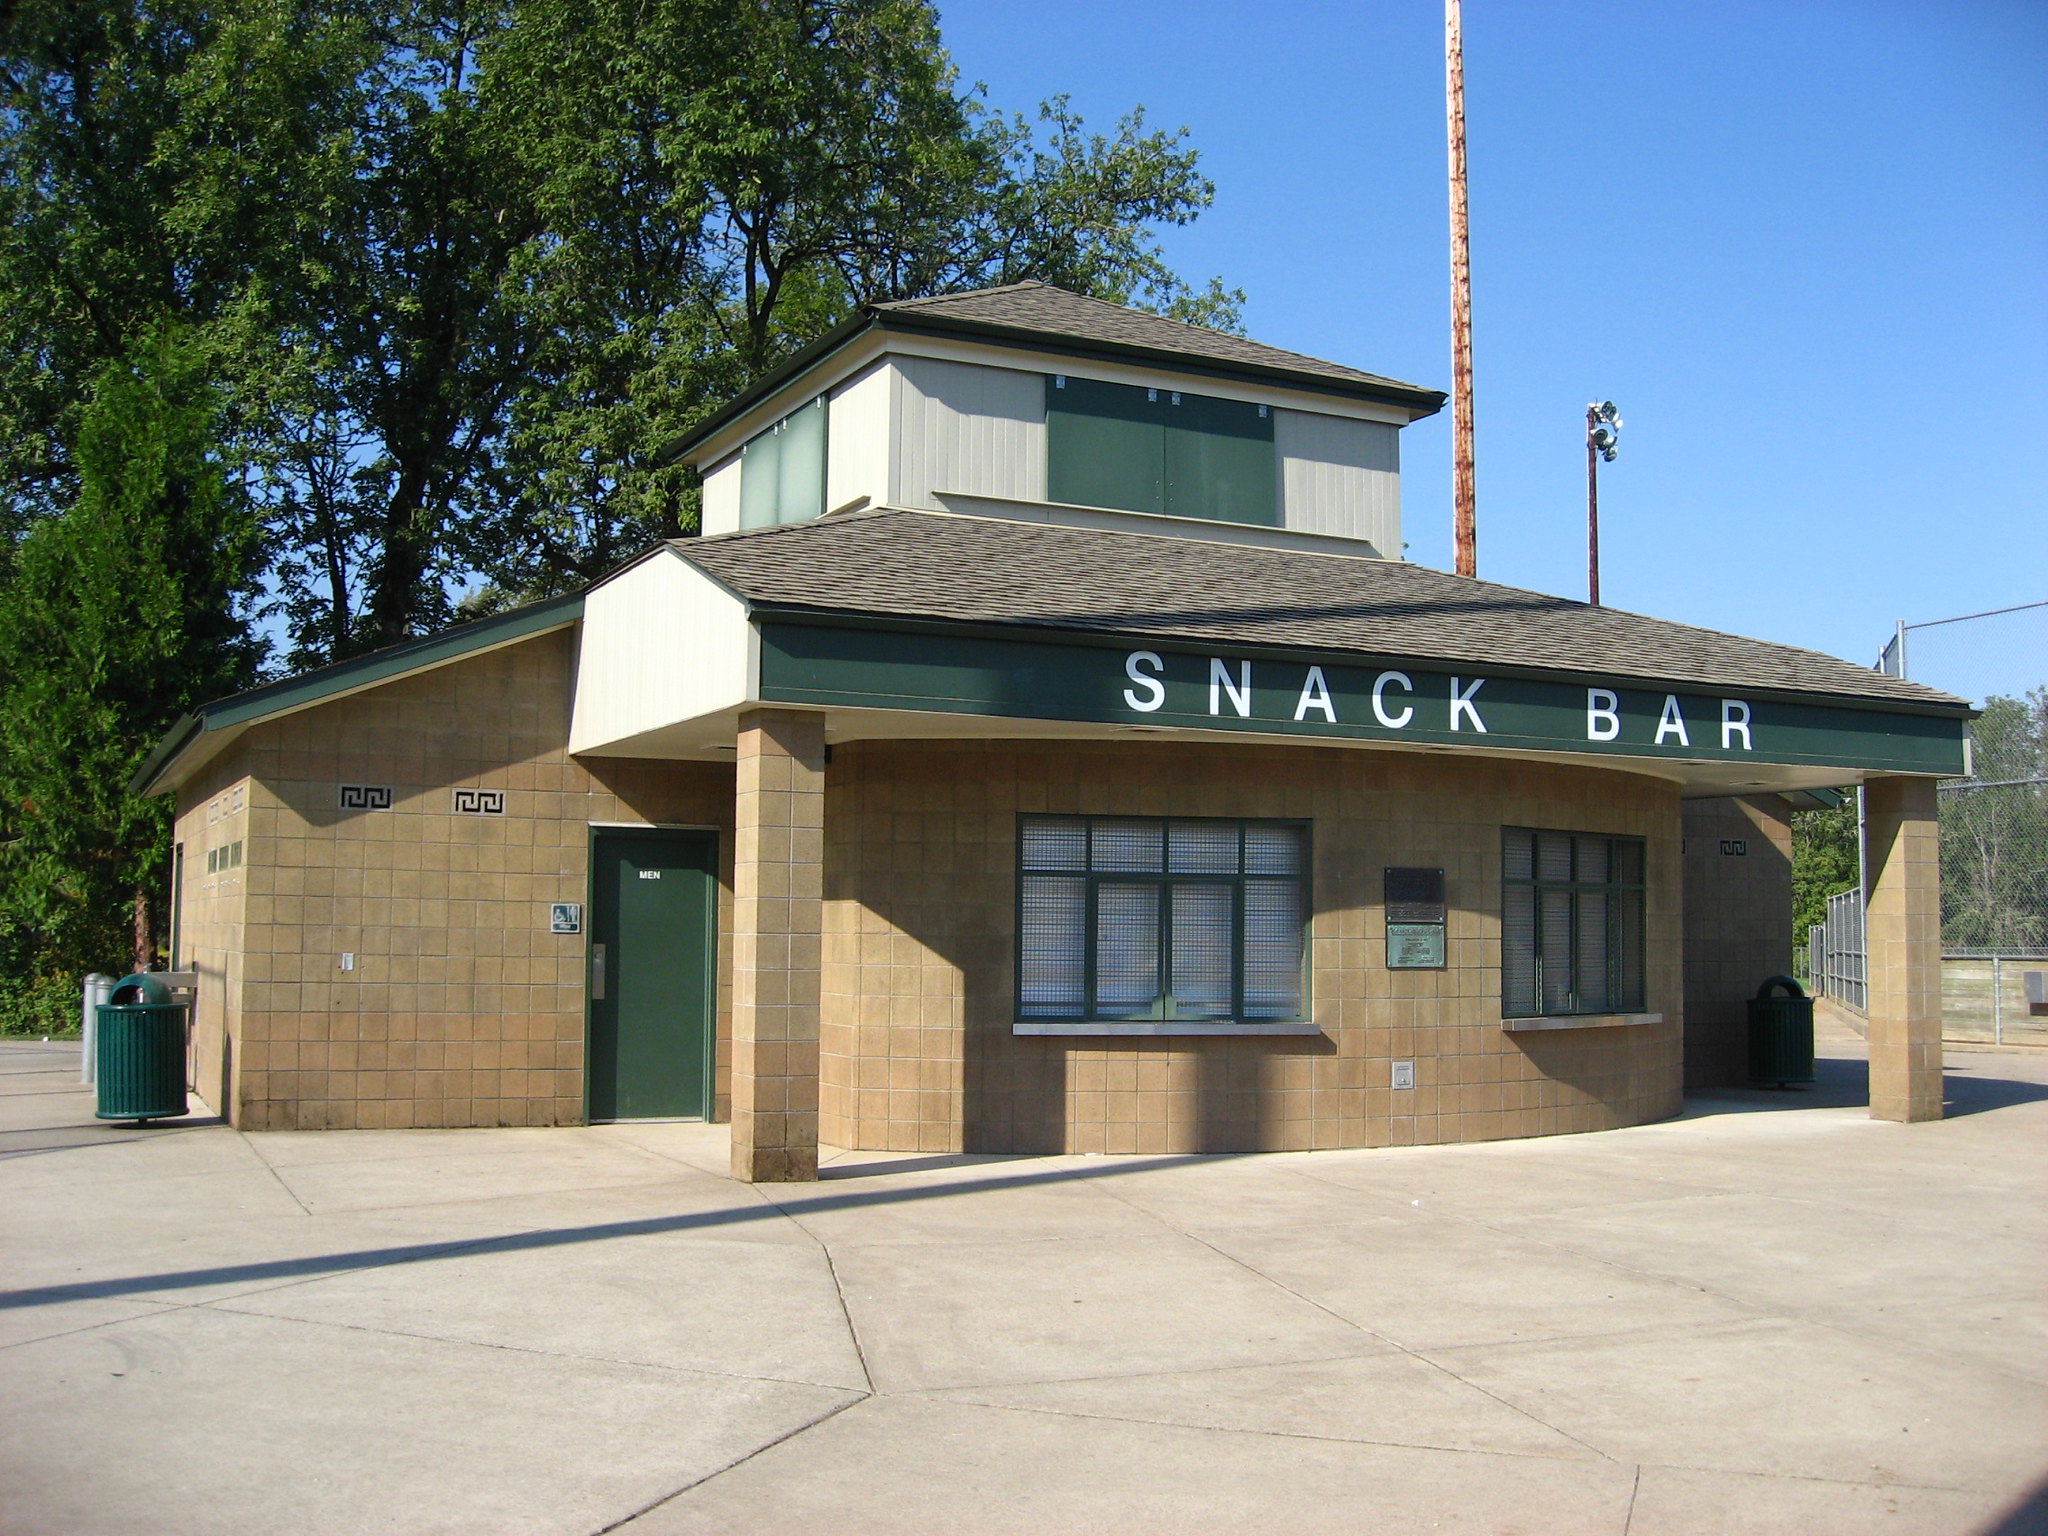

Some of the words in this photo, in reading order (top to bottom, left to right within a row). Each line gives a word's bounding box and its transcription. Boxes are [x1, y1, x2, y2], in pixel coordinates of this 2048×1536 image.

[1122, 650, 1489, 734] SNACK
[1586, 687, 1753, 751] BAR
[639, 870, 661, 880] MEN
